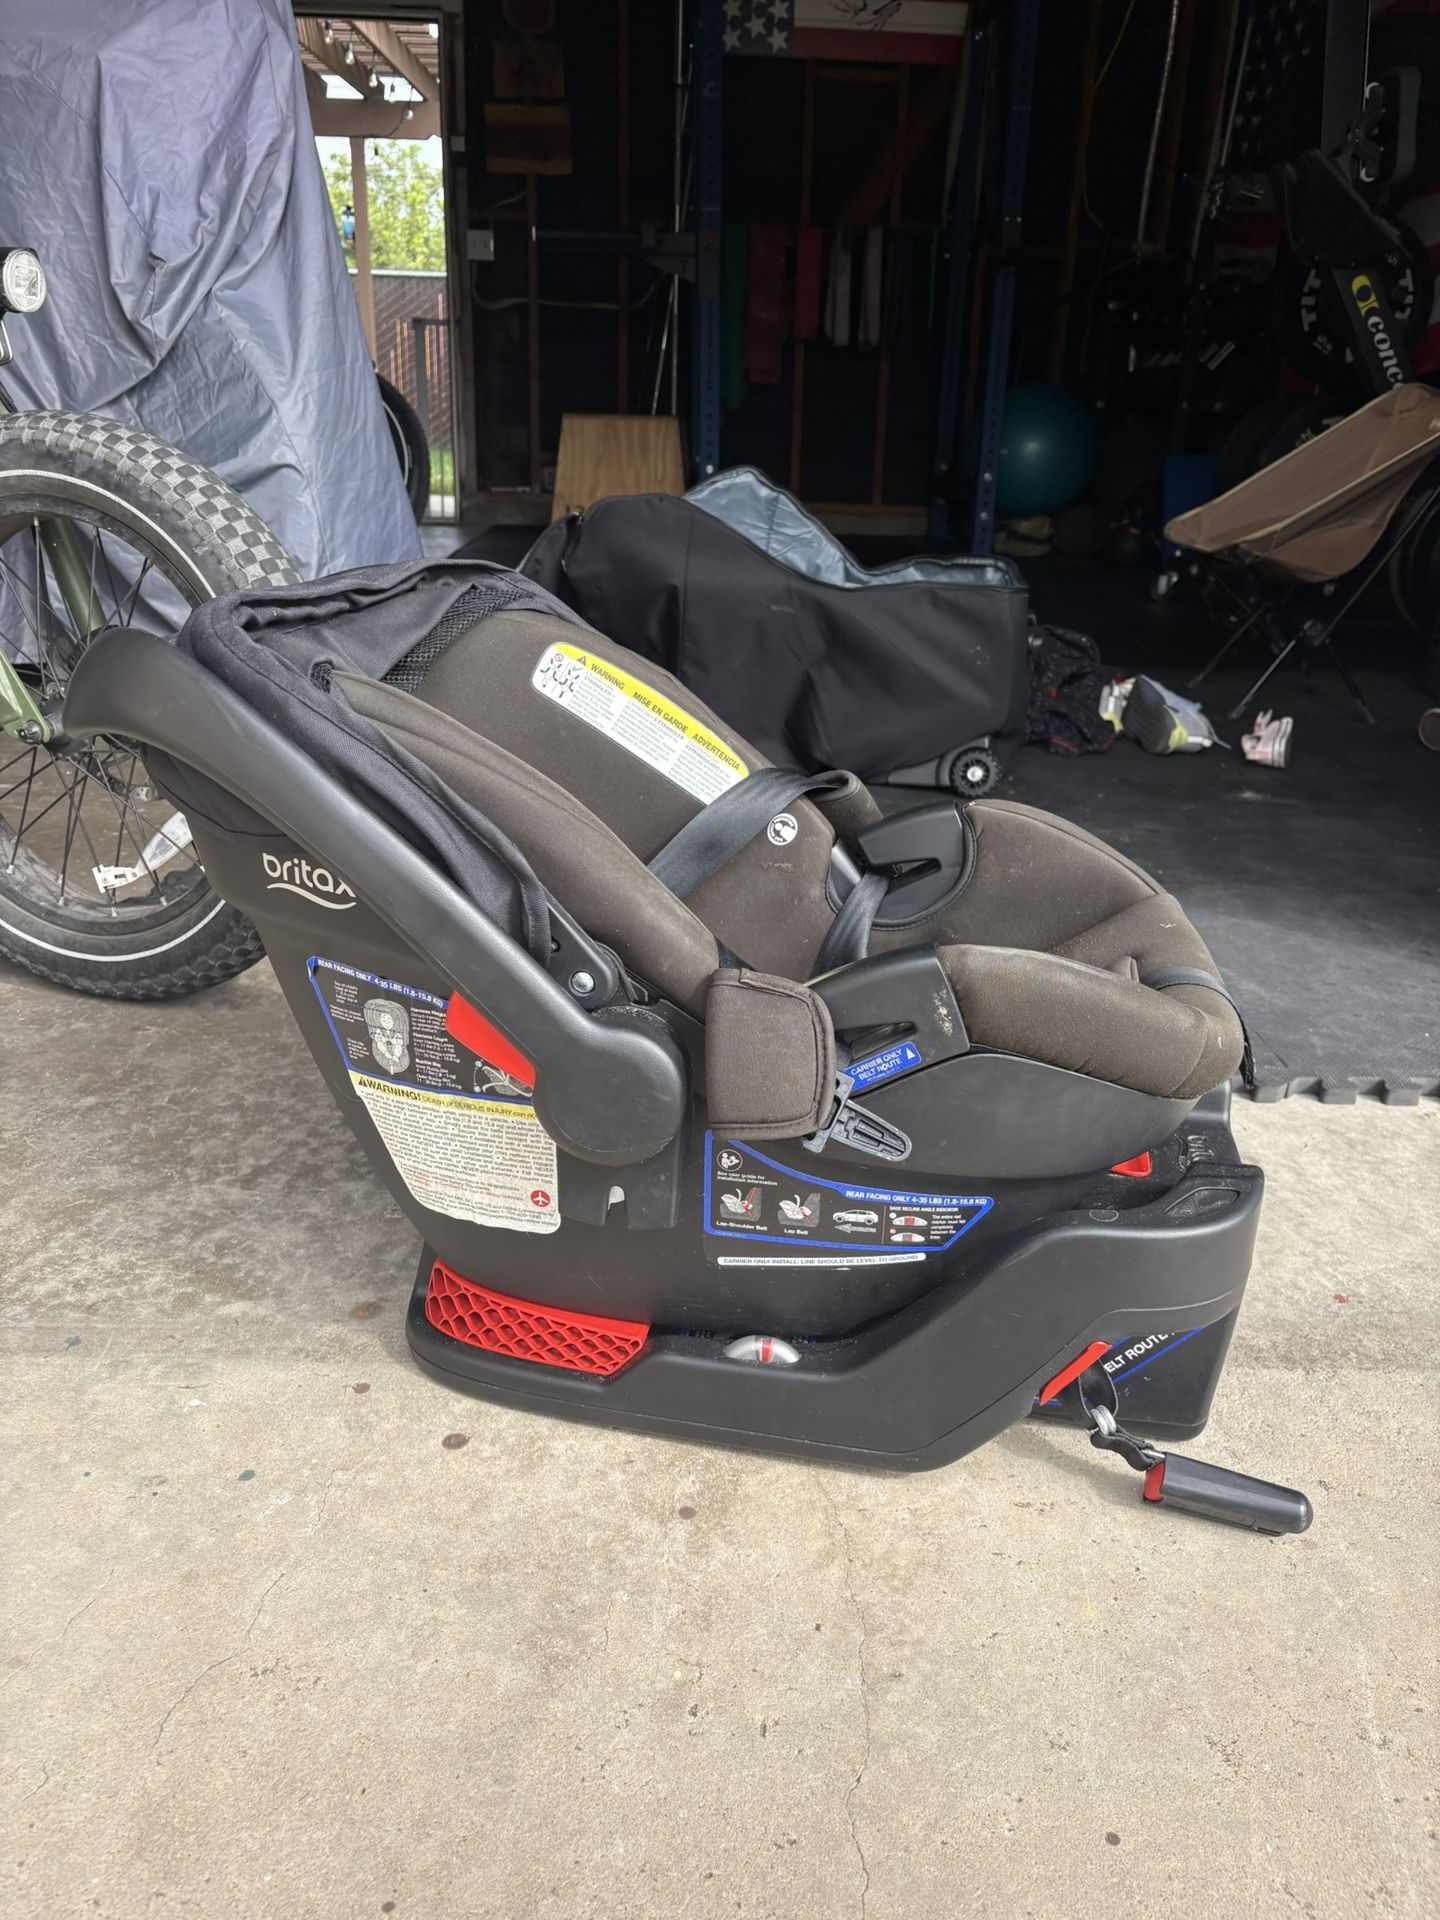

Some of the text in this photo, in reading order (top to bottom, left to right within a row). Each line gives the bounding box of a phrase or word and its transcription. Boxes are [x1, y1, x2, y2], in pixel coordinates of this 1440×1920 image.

[1366, 314, 1404, 388] conc
[590, 663, 626, 690] WARNING
[632, 691, 689, 733] MISE EN GARDE
[692, 733, 740, 771] ADVERTENCIA
[262, 852, 356, 898] britax
[318, 959, 333, 969] REAR
[333, 964, 356, 977] FACING
[355, 970, 372, 982] ONLY
[850, 1058, 883, 1076] CARRIER
[882, 1048, 902, 1062] ONLY
[858, 1068, 876, 1080] BELT
[876, 1058, 902, 1072] ROUTE
[366, 1080, 421, 1100] WARNING!
[422, 1096, 445, 1106] DEATH
[454, 1100, 486, 1112] SERIOUS
[486, 1105, 512, 1115] INJURY
[846, 1190, 864, 1199] REAR
[866, 1192, 892, 1201] FACING
[912, 1196, 928, 1204] 4-35
[975, 1198, 988, 1206] KG)
[716, 1220, 754, 1229] Lap-Shoulder
[1103, 1354, 1128, 1373] ELT
